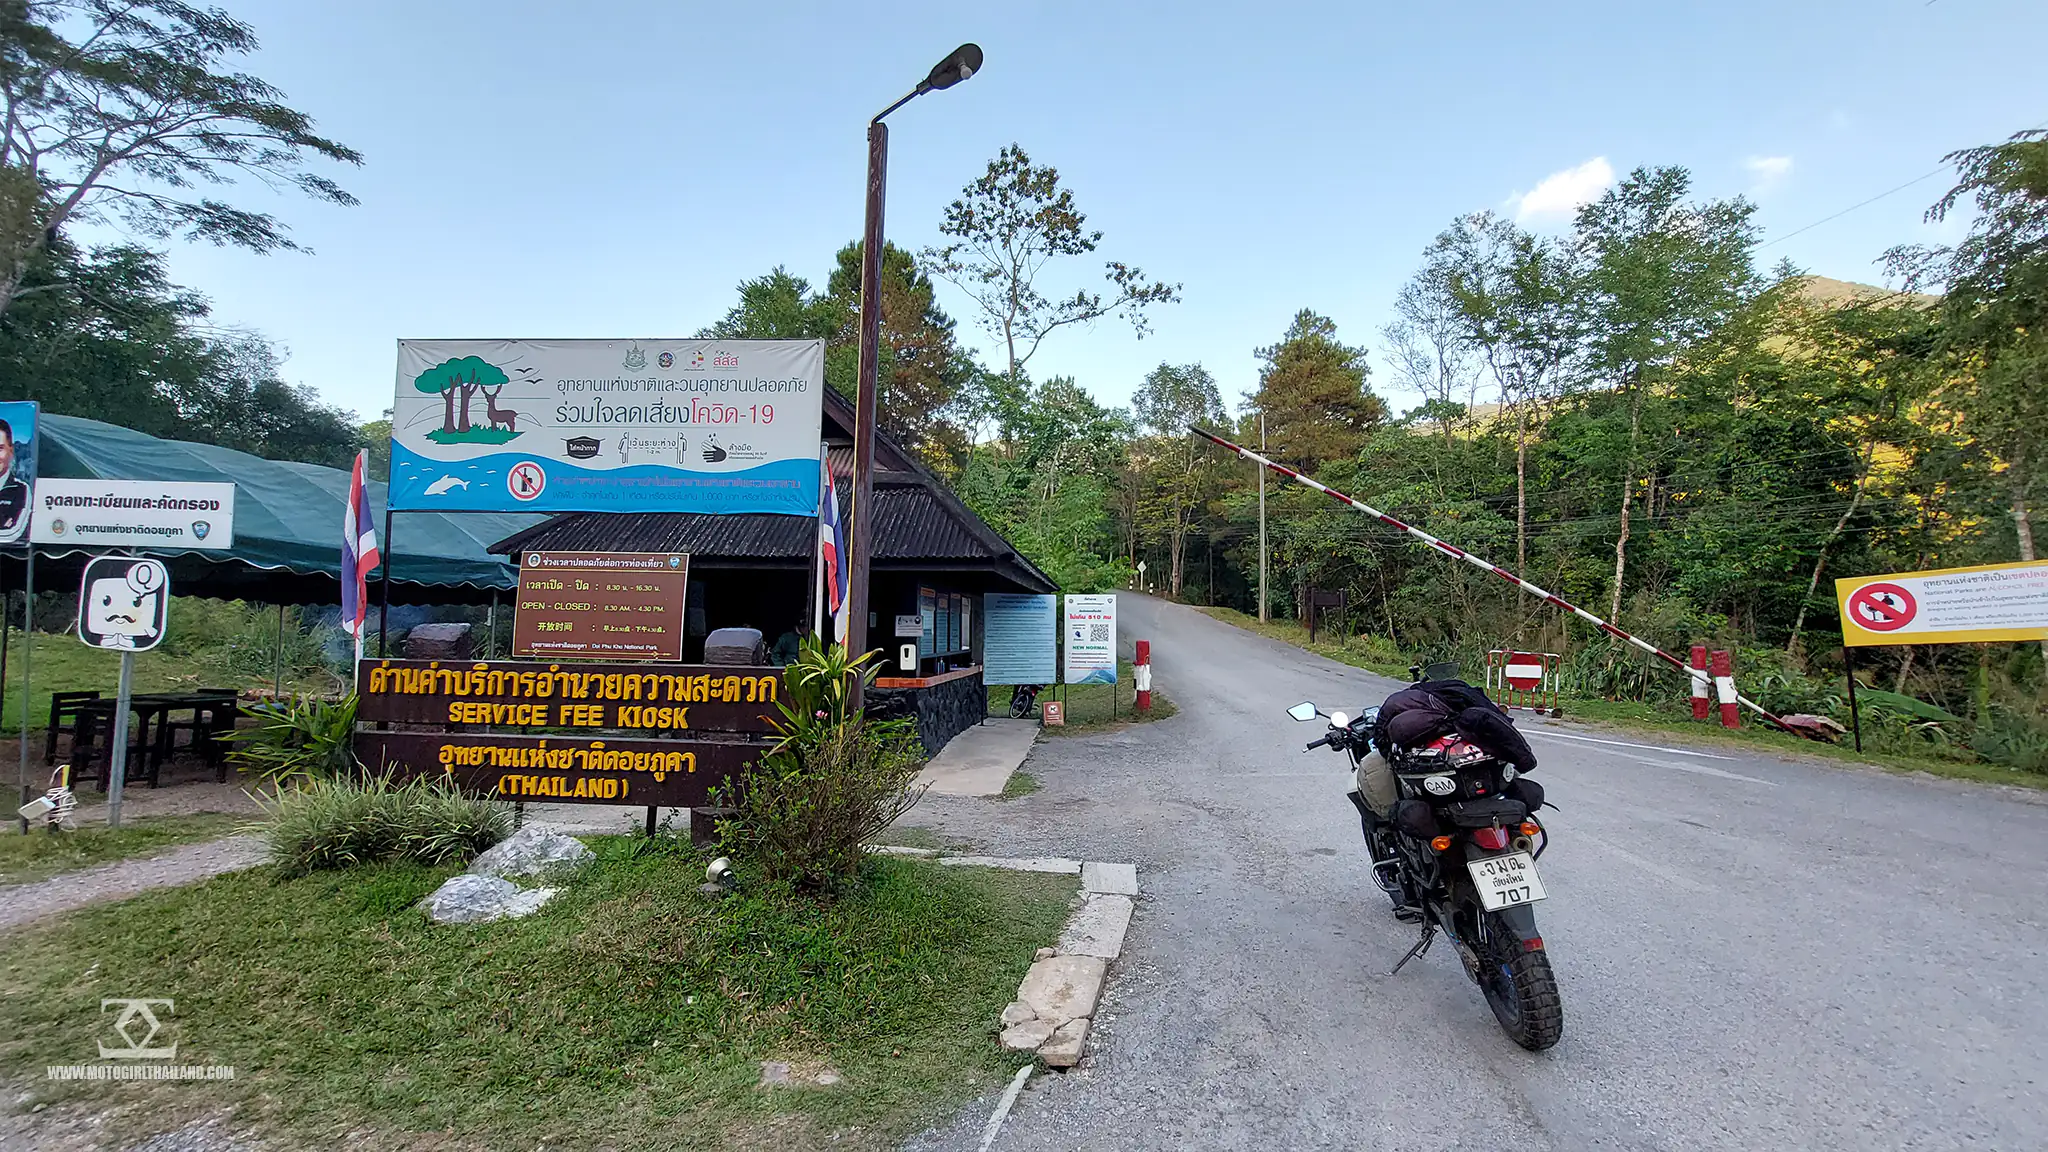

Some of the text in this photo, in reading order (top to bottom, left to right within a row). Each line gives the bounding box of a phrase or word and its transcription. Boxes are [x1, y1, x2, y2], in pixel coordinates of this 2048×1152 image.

[557, 377, 808, 396] อุทยานแห่งชาติและวนอุทยานปลอดภัย
[555, 397, 774, 424] ร่วมใจลดเสี่ยงโควิด-19
[629, 438, 677, 447] เว้นระยะห่าง
[729, 443, 752, 451] ล้างมือ
[45, 493, 220, 511] จุดลงทะเบียนและคัดกรอง
[75, 523, 184, 540] อุทยานแห่งชาติดอยภูคา
[136, 564, 153, 590] Q
[526, 578, 563, 590] เวลาเปิด
[575, 578, 590, 591] ปิด
[1924, 588, 1953, 596] National
[521, 601, 546, 610] OPEN
[554, 602, 591, 611] CLOSED
[537, 622, 573, 632] 开放时间
[369, 660, 778, 703] ด่านค่าบริการอำนวยความสะดวก
[448, 701, 689, 729] SERVICE FEE KIOSK
[438, 738, 697, 783] อุทยานแห่งชาติดอยภูคา
[498, 774, 630, 799] (THAILAND)
[1425, 779, 1455, 792] CAM
[1493, 871, 1525, 887] เชียงใหม่
[1496, 885, 1530, 905] 707
